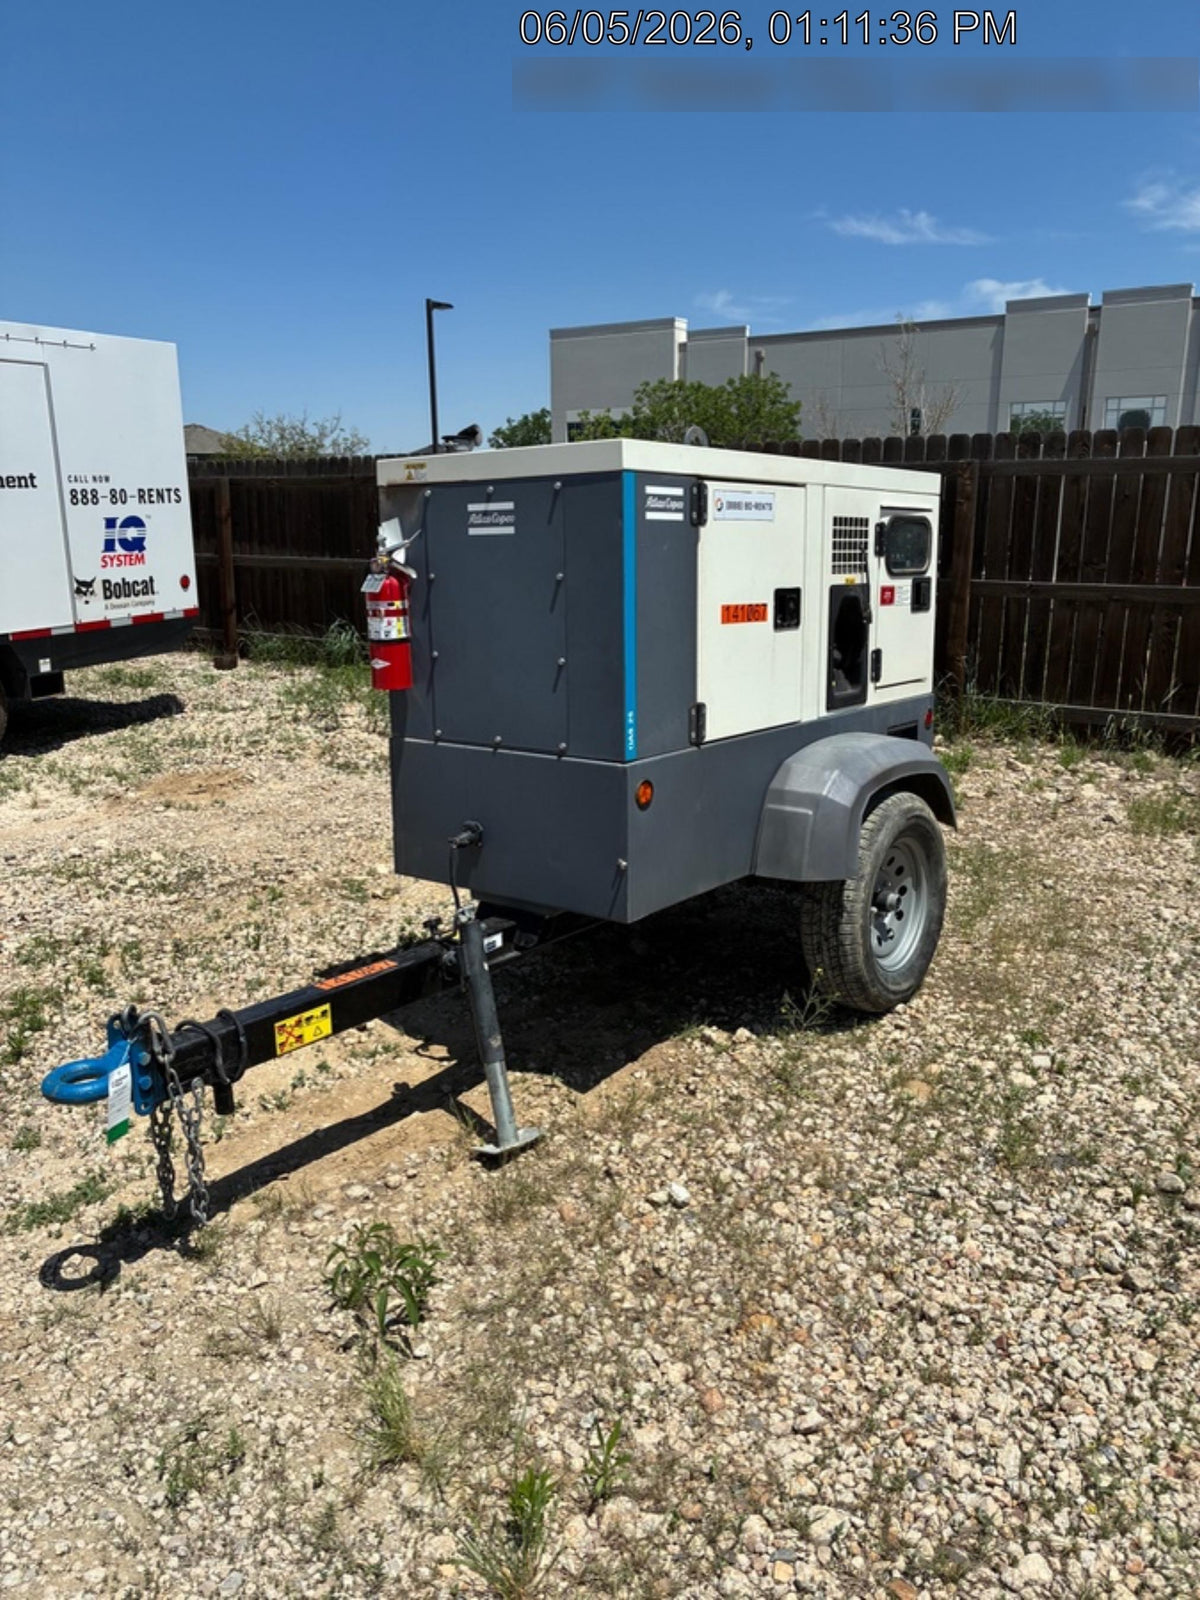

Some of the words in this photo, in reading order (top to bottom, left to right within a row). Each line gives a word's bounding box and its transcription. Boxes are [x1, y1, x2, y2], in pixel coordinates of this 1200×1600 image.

[67, 474, 89, 484] CALL
[92, 475, 111, 483] NOW
[69, 487, 182, 506] 888-80-RENTS
[101, 515, 147, 553] IQ
[100, 553, 146, 569] SYSTEM
[102, 576, 156, 600] Bobcat
